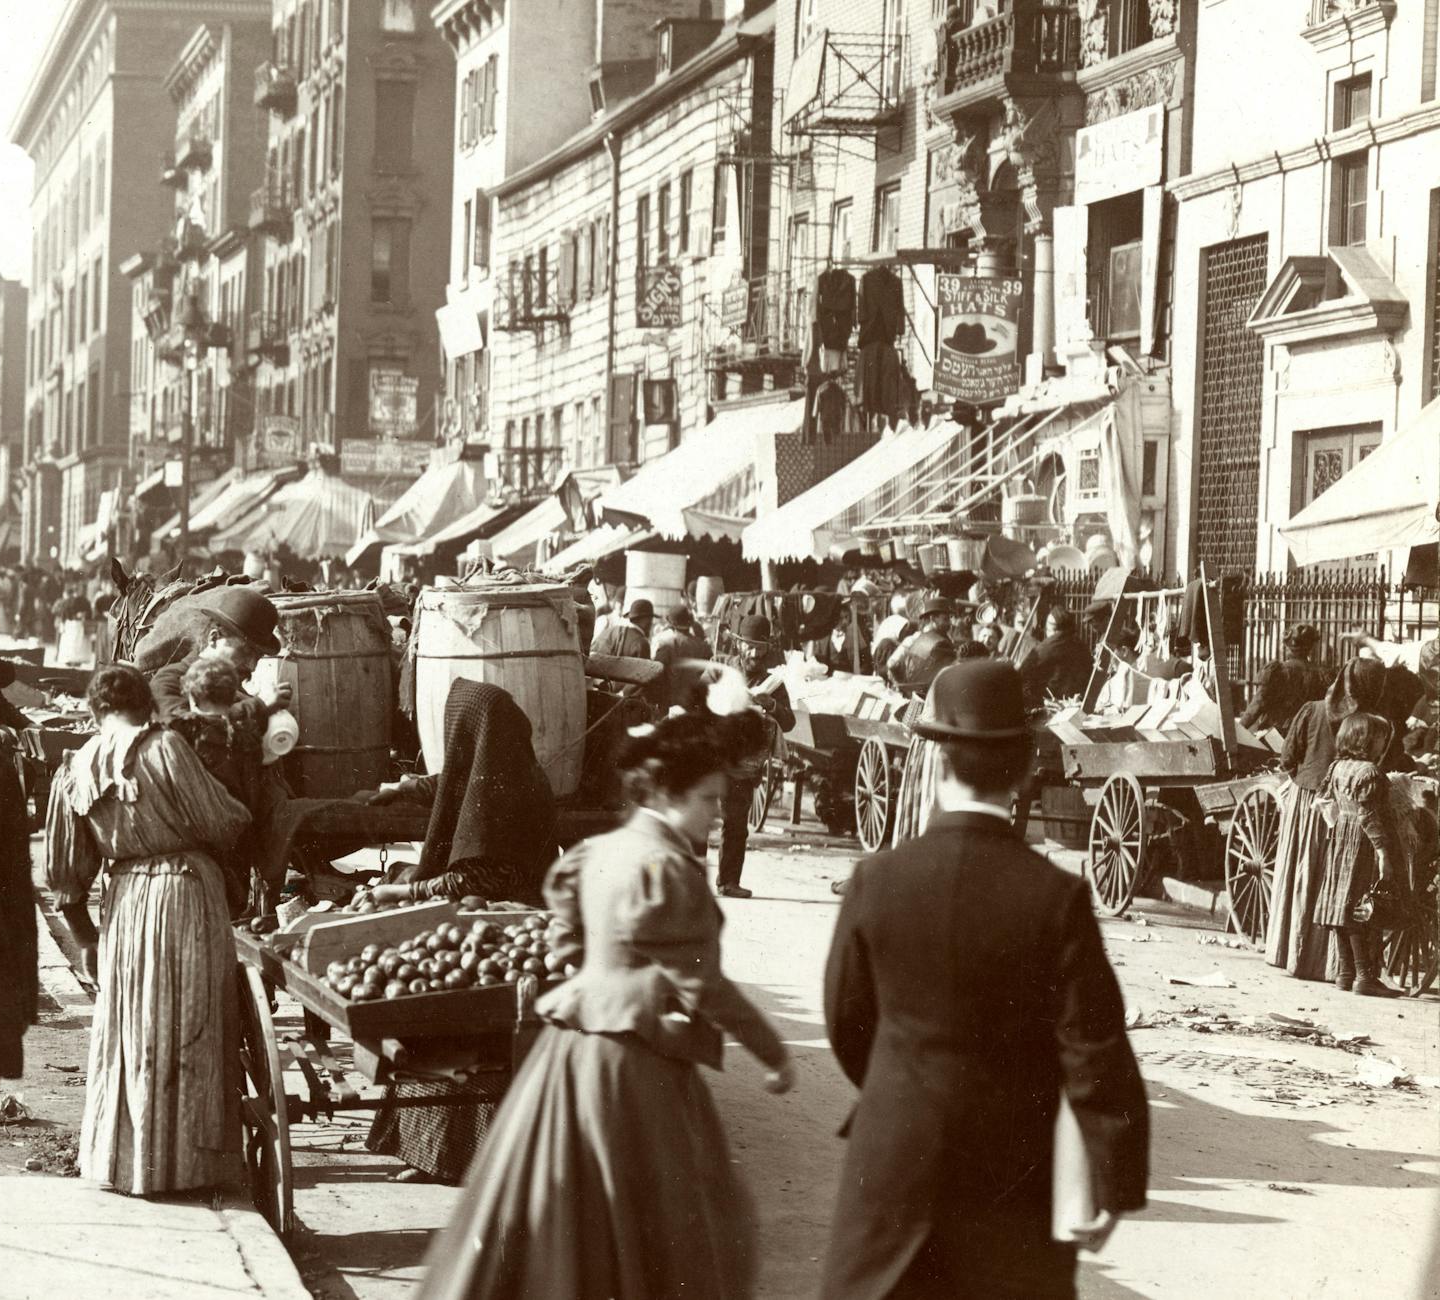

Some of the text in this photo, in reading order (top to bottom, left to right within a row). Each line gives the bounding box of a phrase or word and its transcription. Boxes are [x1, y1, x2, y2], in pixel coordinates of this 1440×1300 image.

[939, 277, 961, 292] 39
[1002, 280, 1023, 296] 39
[638, 271, 680, 321] SIGNS
[944, 288, 1009, 305] STIFF & SILK
[950, 301, 1007, 317] HATS
